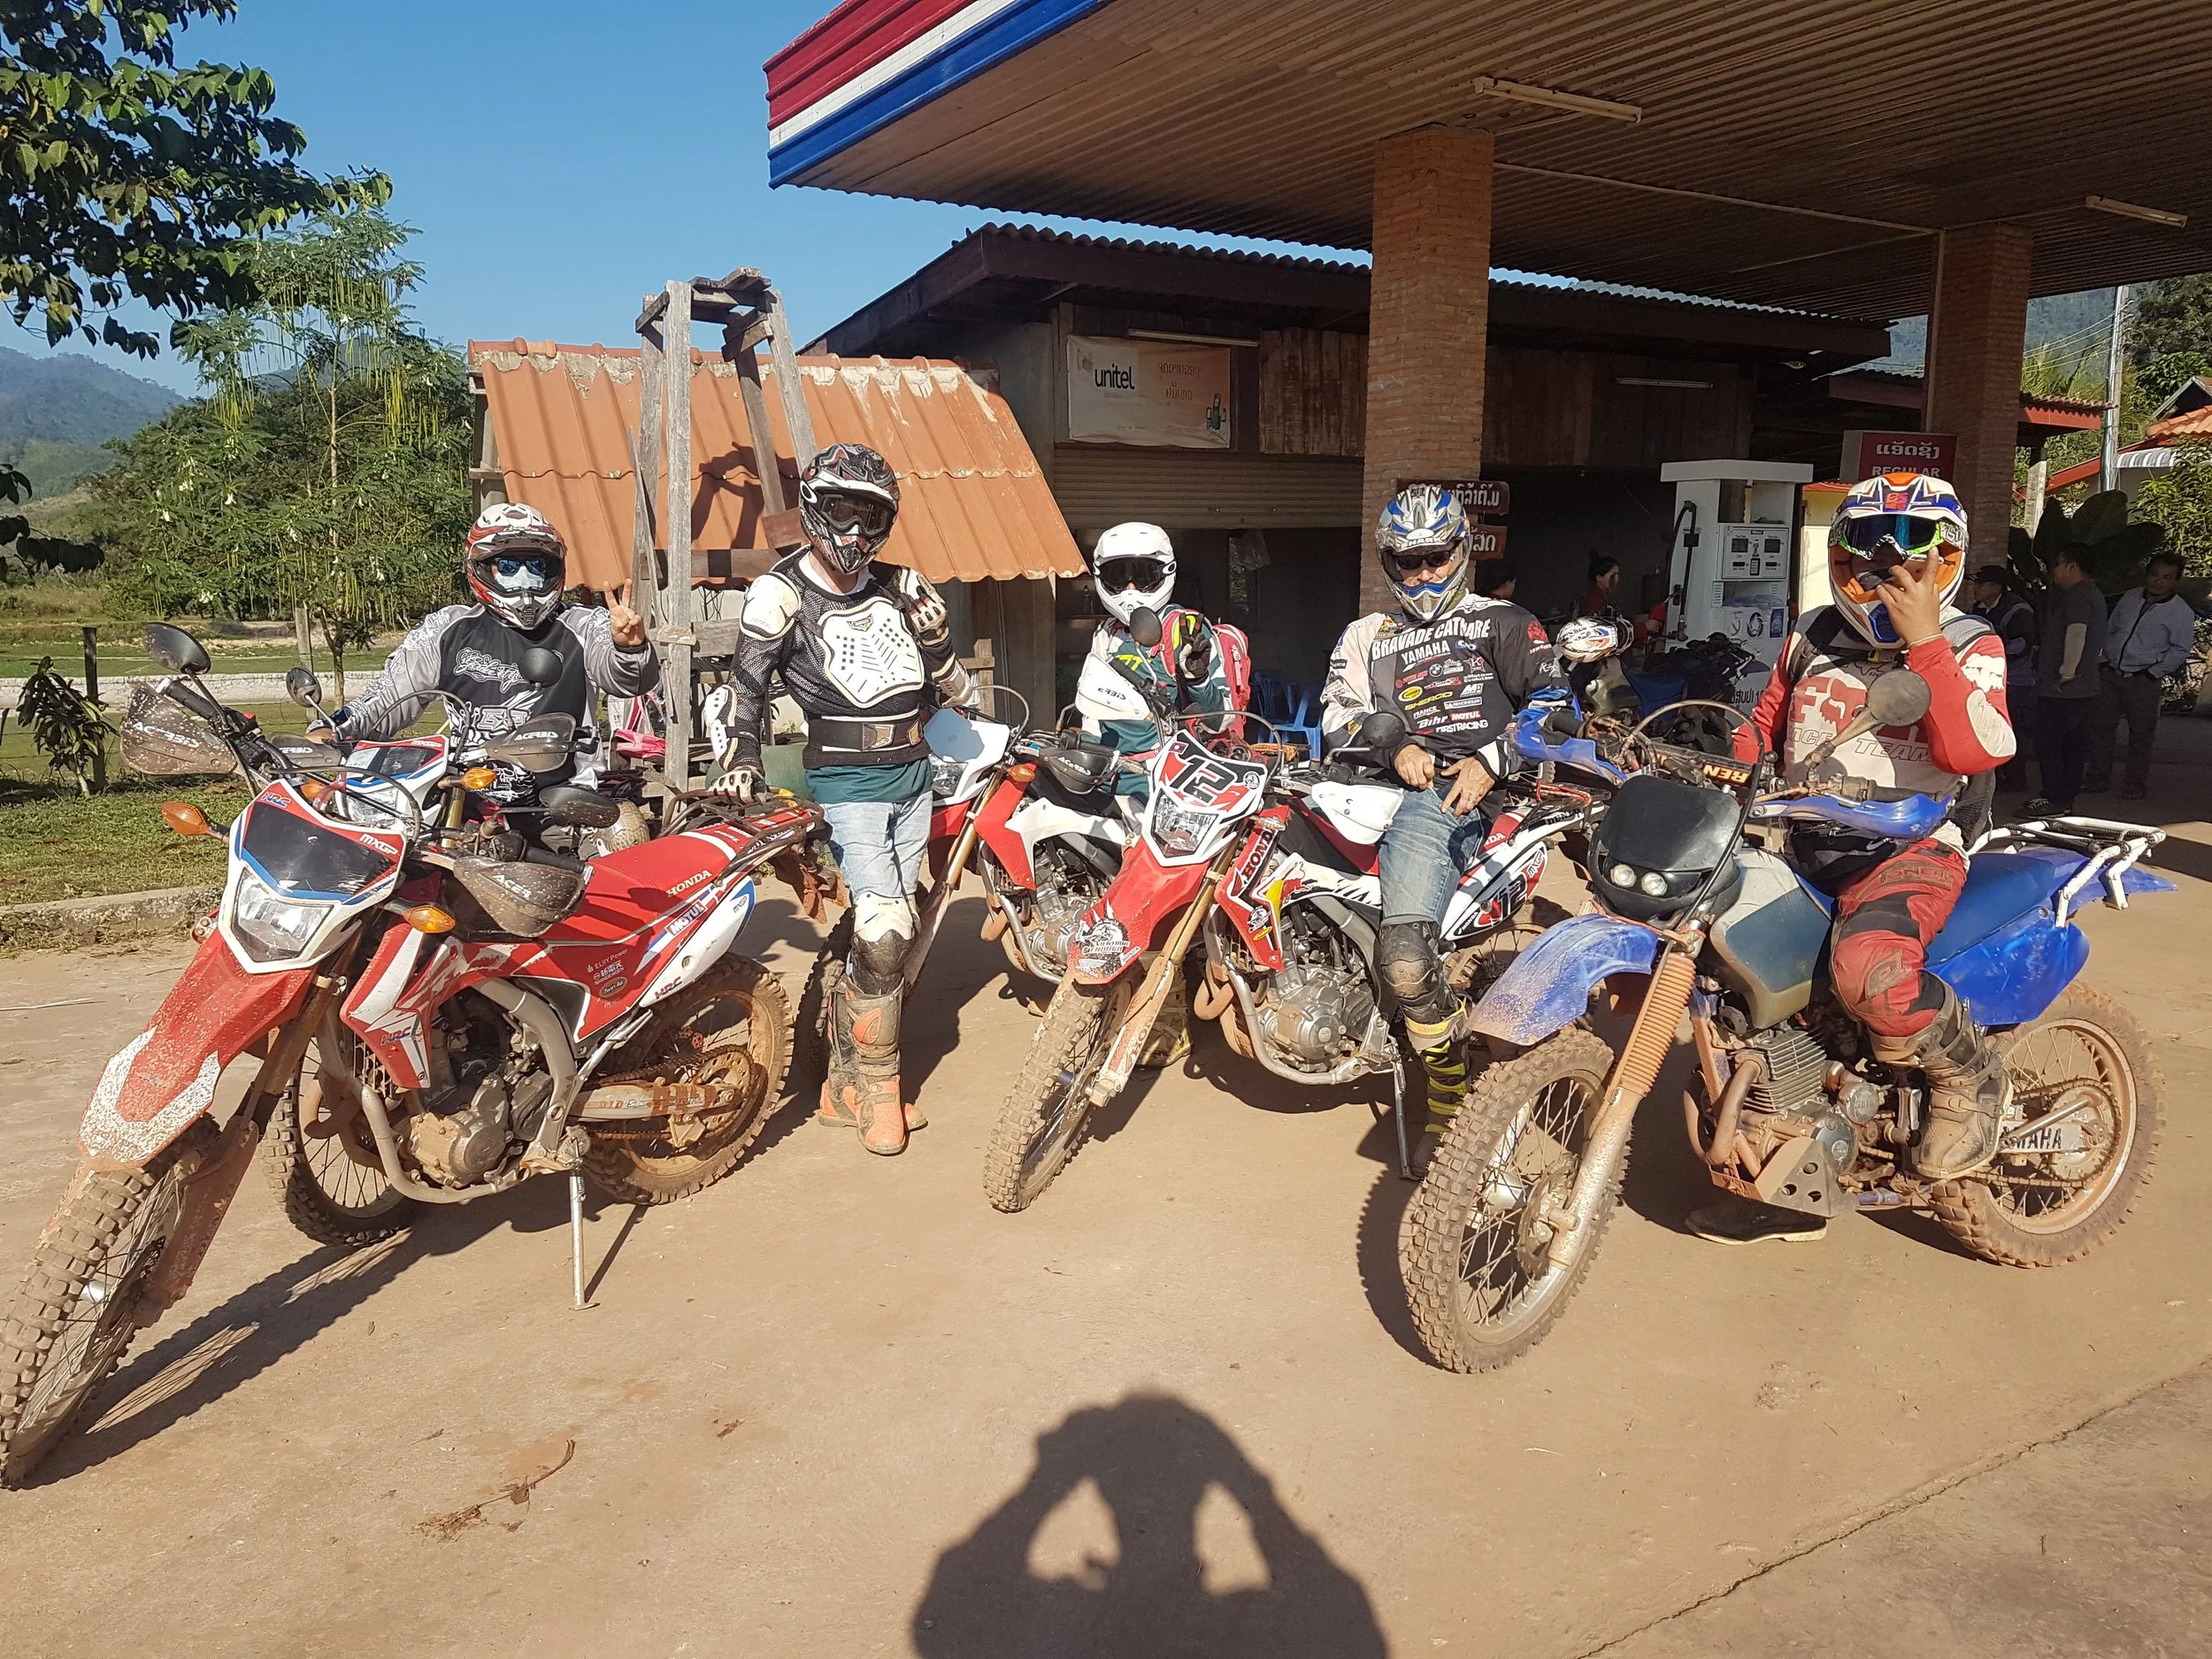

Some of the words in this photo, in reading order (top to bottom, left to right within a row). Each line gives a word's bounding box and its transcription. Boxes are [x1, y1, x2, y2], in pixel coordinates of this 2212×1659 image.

[1094, 363, 1135, 389] unitel
[1371, 627, 1434, 661] BRAVADE
[1401, 640, 1451, 665] YAMAHA
[1404, 691, 1454, 710] SHERCO
[1451, 710, 1481, 721] MOTUL
[1169, 757, 1236, 803] 12
[358, 833, 399, 856] MXGP
[1240, 828, 1276, 882] HOND
[665, 870, 713, 899] HONDA
[669, 902, 707, 936] MOTUL
[1462, 911, 1479, 931] HONDA
[610, 948, 629, 962] Power
